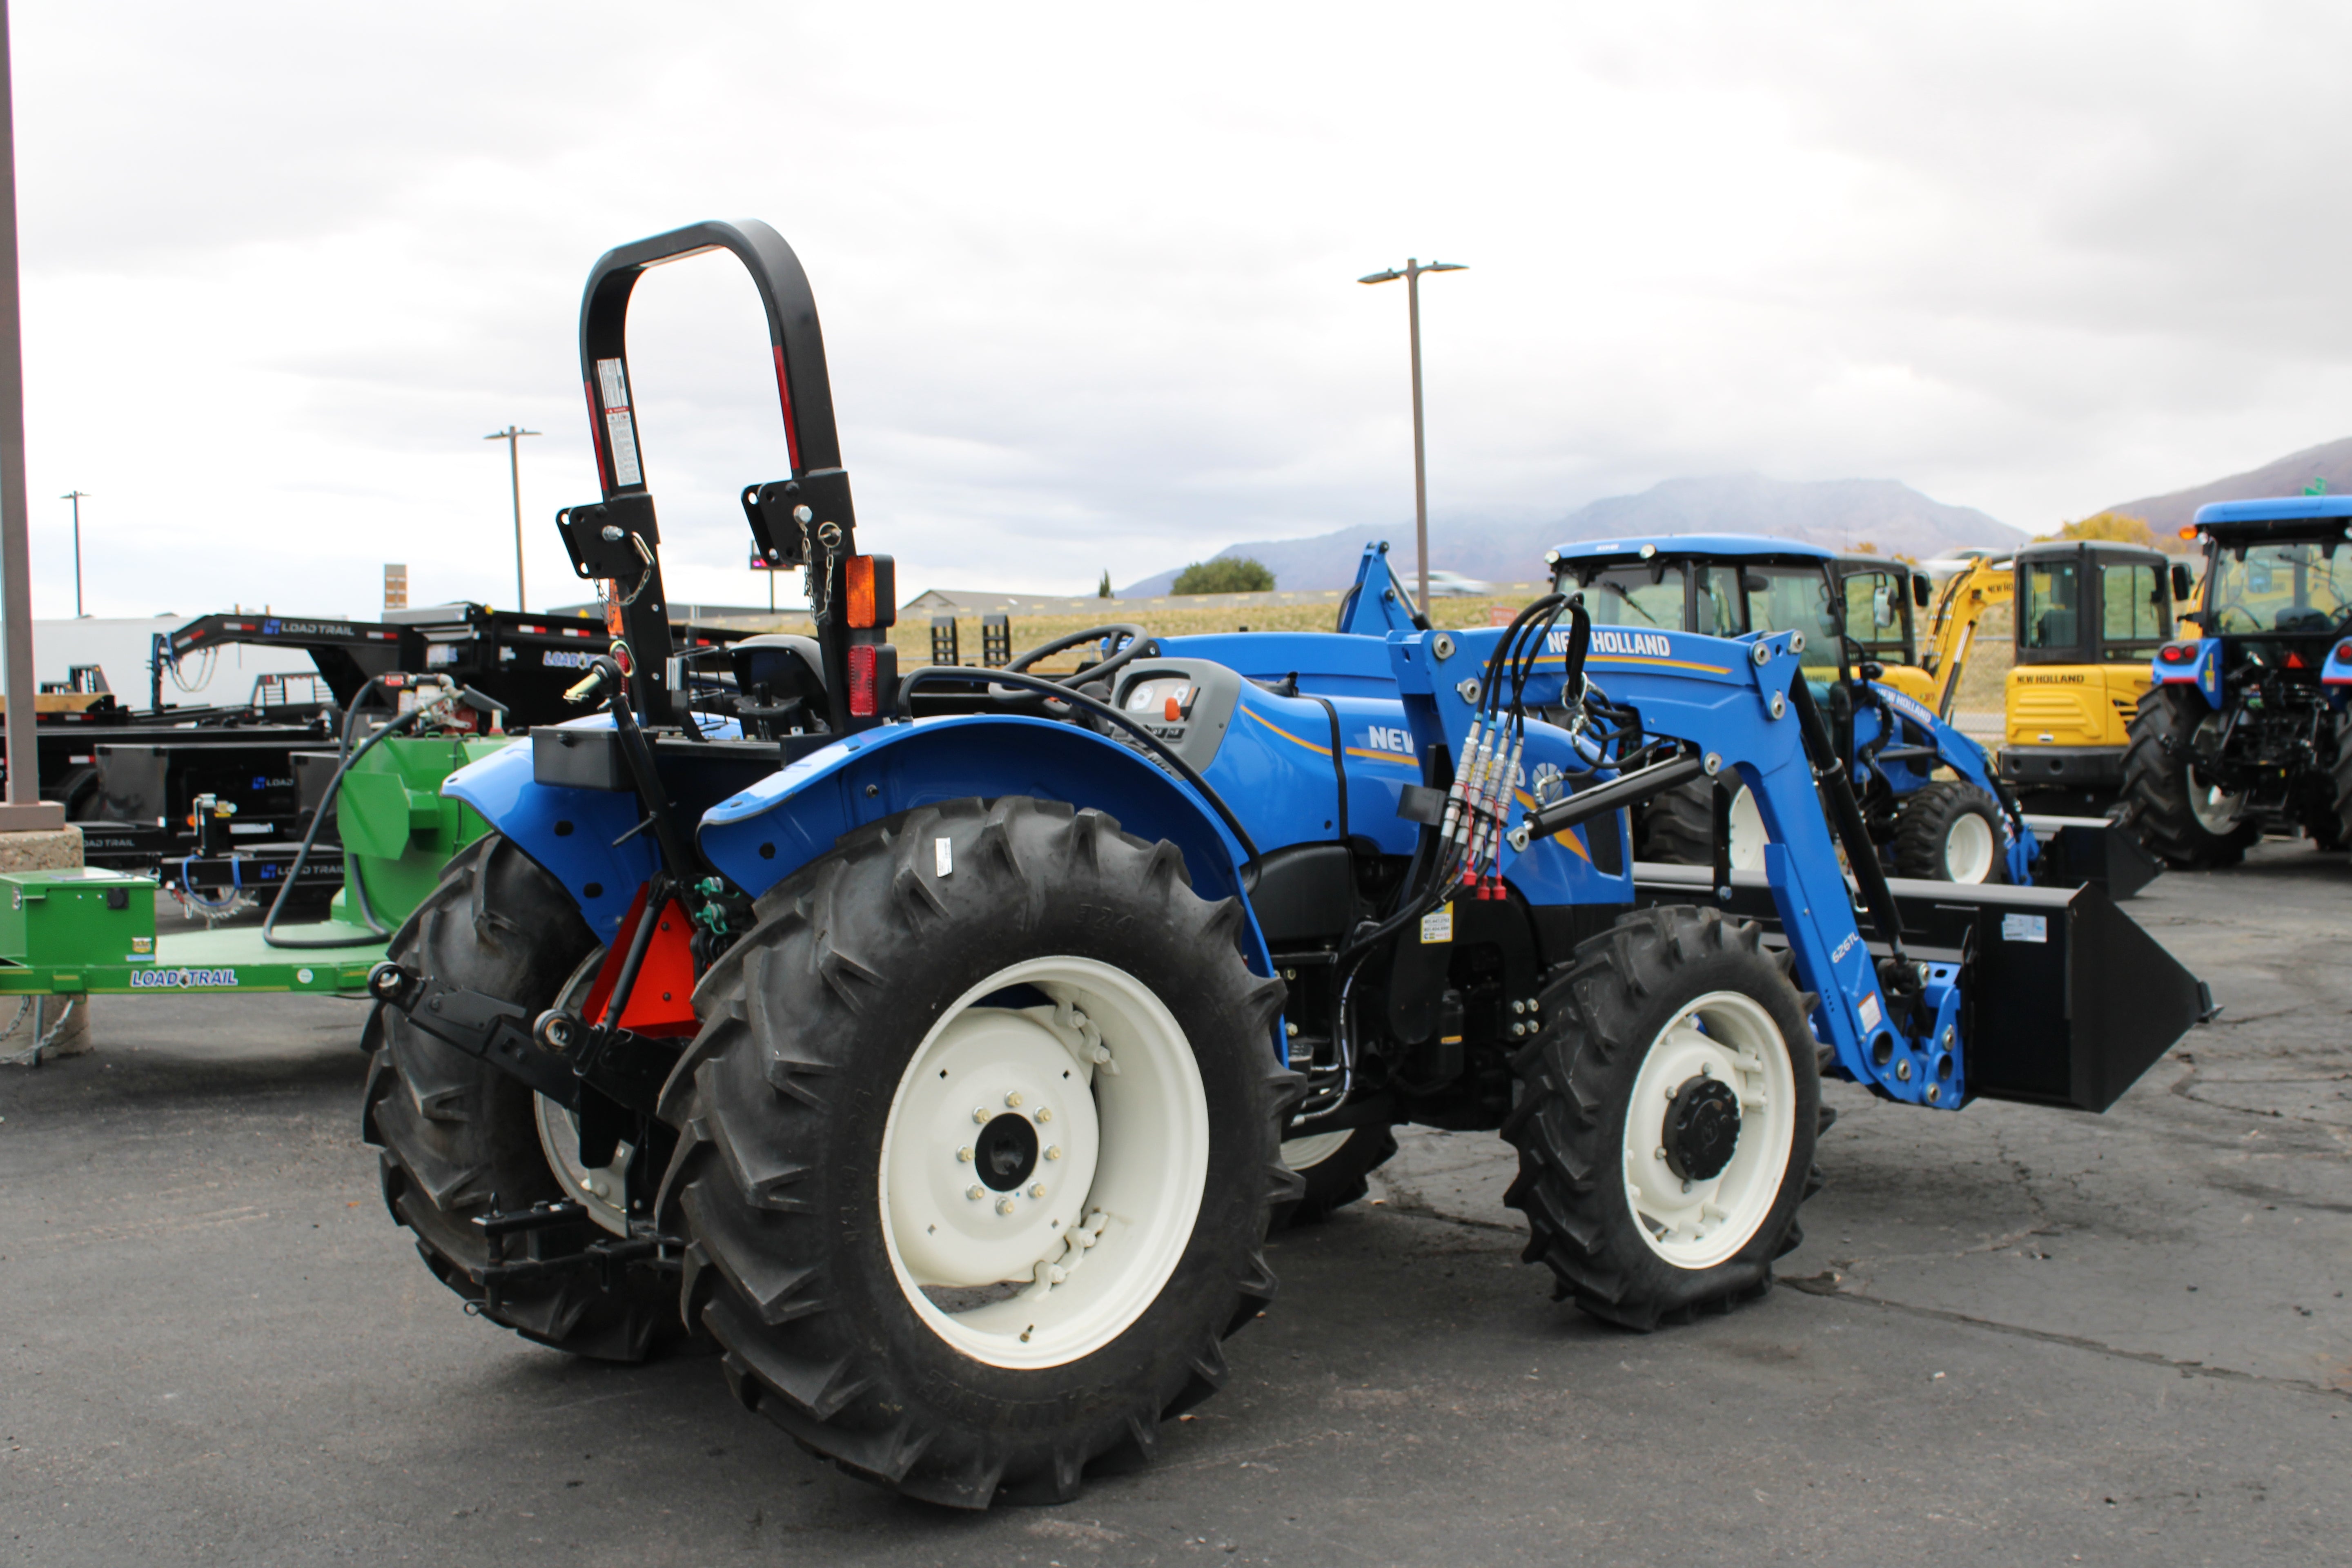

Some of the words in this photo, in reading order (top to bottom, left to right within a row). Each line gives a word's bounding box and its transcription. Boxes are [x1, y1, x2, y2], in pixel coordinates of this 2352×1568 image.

[281, 623, 317, 633] LOAD
[318, 625, 355, 636] TRAIL
[1547, 632, 1570, 653] NE
[1591, 631, 1670, 657] HOLLAND
[542, 650, 579, 668] LOAD
[2017, 675, 2034, 684] NEW
[2036, 674, 2085, 684] HOLLAND
[1896, 694, 1932, 724] HOLLAND
[265, 779, 294, 787] LOAD
[105, 839, 135, 847] TRAIL
[1832, 932, 1860, 963] 626TL
[130, 970, 180, 987] LOAD
[188, 969, 238, 986] TRAIL
